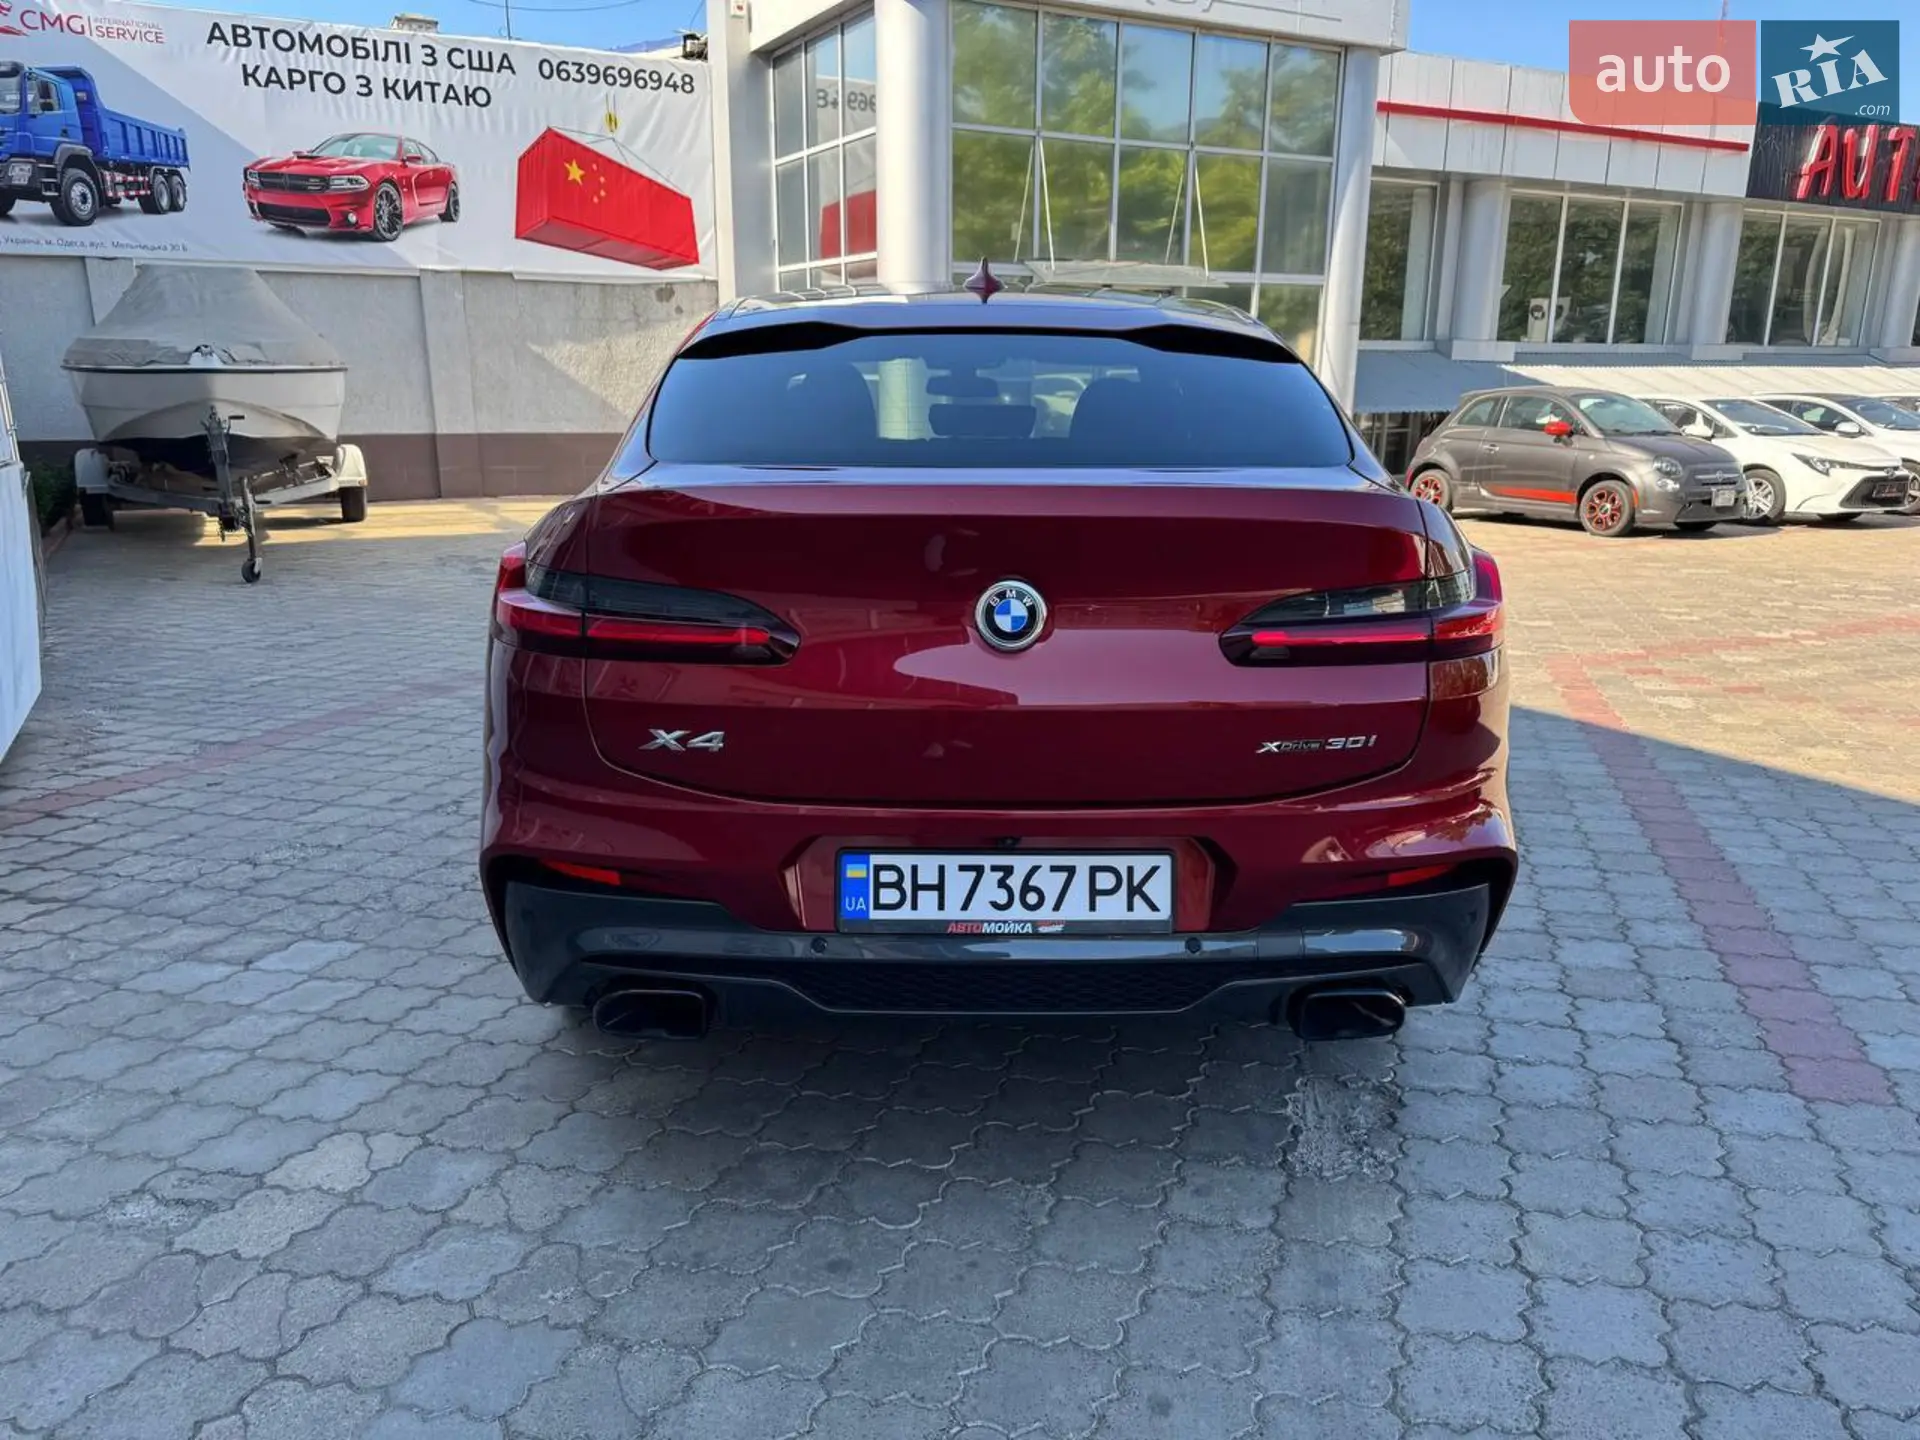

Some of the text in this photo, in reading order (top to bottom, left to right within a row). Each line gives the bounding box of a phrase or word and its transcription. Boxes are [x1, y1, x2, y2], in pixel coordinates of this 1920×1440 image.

[19, 10, 85, 35] CMG
[95, 25, 165, 44] SERVICE
[206, 21, 411, 64] АВТОМОБІЛІ
[446, 47, 516, 75] США
[241, 63, 346, 95] КАРГО
[383, 77, 492, 108] КИТАЮ
[538, 58, 695, 94] 0639696948
[1796, 115, 1920, 201] AUT
[989, 588, 1034, 607] BMW
[638, 728, 725, 752] X4
[844, 896, 867, 912] UA
[947, 920, 1033, 934] АВТОМОЙКА
